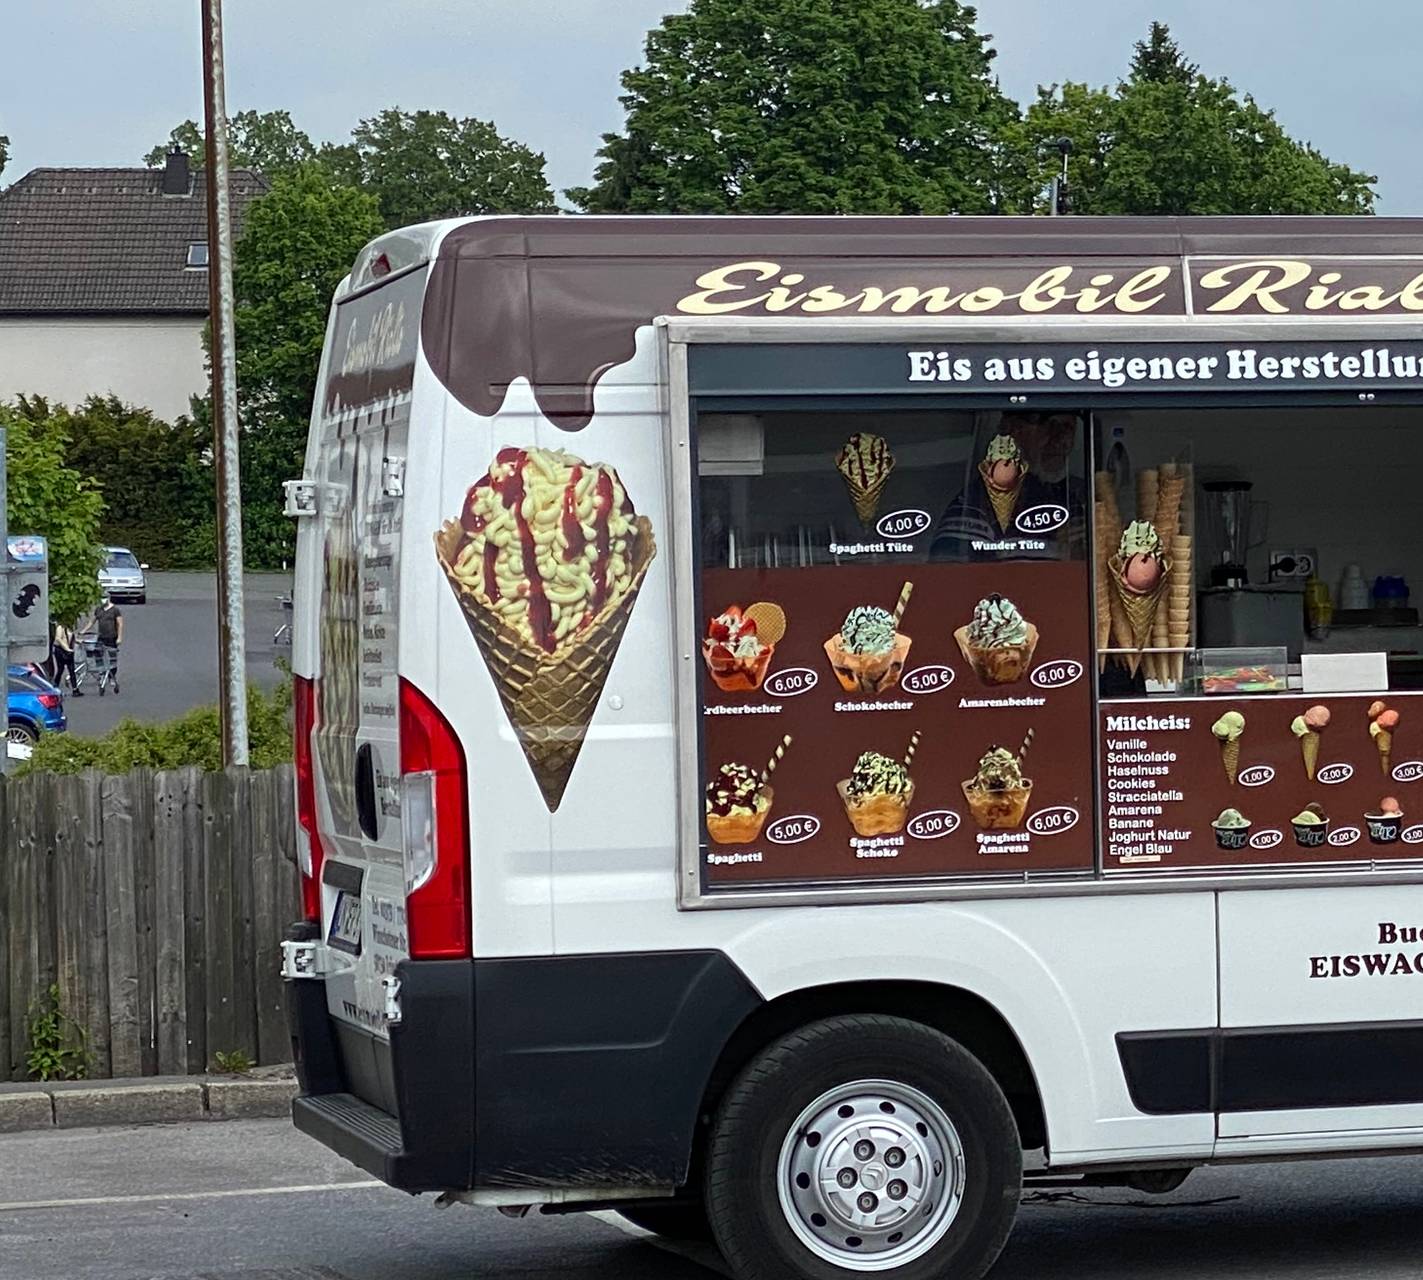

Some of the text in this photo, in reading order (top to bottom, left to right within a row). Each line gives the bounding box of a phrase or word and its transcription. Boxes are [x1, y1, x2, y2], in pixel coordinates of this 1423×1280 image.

[676, 261, 1171, 314] Eismobil
[907, 351, 972, 381] Eis
[983, 355, 1054, 381] aus
[1064, 350, 1218, 387] eigener
[884, 516, 912, 534] 4,00
[915, 514, 926, 529] €
[1023, 509, 1063, 530] 4,50 €
[829, 541, 914, 554] Spaghetti Tüte
[972, 539, 1045, 551] Wunder Tüte
[775, 671, 815, 690] 6,00 €
[911, 670, 953, 690] 5,00 €
[1039, 664, 1078, 684] 6,00 €
[834, 700, 914, 713] Schokobecher
[958, 696, 1046, 709] Amarenabecher
[1106, 715, 1191, 732] Milcheis:
[1107, 739, 1148, 750] Vanille
[1107, 752, 1177, 763] Schokolade
[1107, 765, 1169, 777] Haselnuss
[1107, 778, 1156, 790] Cookies
[1108, 790, 1184, 803] Stracciatella
[1108, 804, 1163, 816] Amarena
[915, 815, 955, 837] 5,00 €
[1034, 810, 1073, 832] 6,00 €
[1109, 818, 1154, 829] Banane
[775, 818, 814, 842] 5,00 €
[849, 837, 904, 849] Spaghetti
[976, 833, 1030, 845] Spaghetti
[1109, 830, 1192, 844] Joghurt Natur
[856, 848, 898, 858] Schoko
[978, 844, 1029, 855] Amarena
[1109, 843, 1173, 856] Engel Blau
[707, 852, 763, 865] Spaghetti
